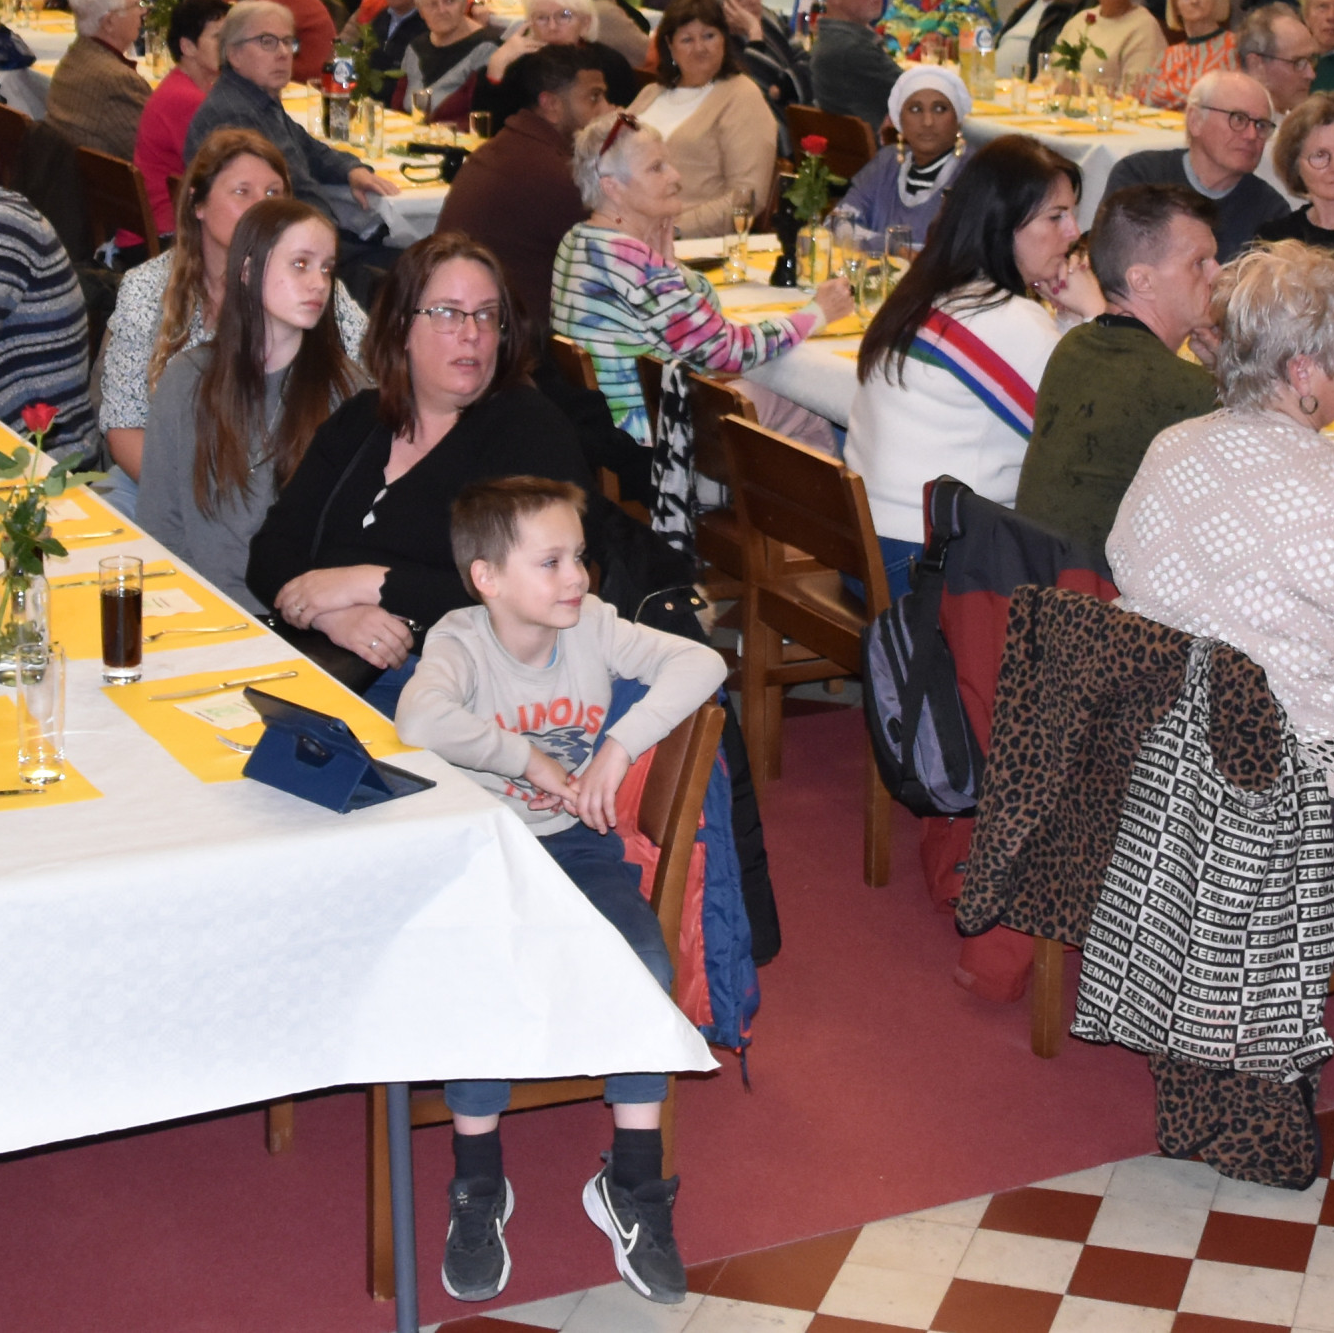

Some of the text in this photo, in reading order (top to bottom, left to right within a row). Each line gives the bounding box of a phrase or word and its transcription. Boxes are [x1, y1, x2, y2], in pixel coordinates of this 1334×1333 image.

[1134, 766, 1169, 789] EEMAN
[1130, 784, 1165, 807] EEMAN
[1125, 801, 1161, 825] EEMAN
[1120, 818, 1157, 844] EEMAN
[1219, 814, 1275, 840] ZEEMAN
[1116, 838, 1152, 862] EEMAN
[1215, 832, 1271, 857] ZEEMAN
[1112, 855, 1147, 880] EEMAN
[1210, 850, 1265, 875] ZEEMAN
[1106, 873, 1142, 899] EEMAN
[1205, 869, 1260, 892] ZEEMAN
[1101, 890, 1138, 915] EEMAN
[1154, 876, 1193, 911] ZEEMAN
[1201, 887, 1253, 908] ZEEMAN
[1095, 908, 1132, 935] EEMAN
[1149, 894, 1190, 929] ZEEMAN
[1197, 906, 1246, 926] ZEEMAN
[1090, 925, 1128, 953] EEMAN
[1143, 912, 1186, 948] ZEEMAN
[1193, 926, 1242, 945] ZEEMAN
[1086, 942, 1124, 971] EEMAN
[1139, 931, 1182, 966] ZEEMAN
[1190, 943, 1240, 964] ZEEMAN
[1082, 963, 1119, 989] EEMAN
[1134, 949, 1178, 985] ZEEMAN
[1186, 963, 1239, 982] ZEEMAN
[1129, 967, 1173, 1005] ZEEMAN
[1182, 981, 1238, 1002] ZEEMAN
[1247, 986, 1297, 1002] ZEEMAN
[1124, 986, 1168, 1024] ZEEMAN
[1179, 1001, 1236, 1021] ZEEMAN
[1244, 1004, 1298, 1021] ZEEMAN
[1118, 1004, 1165, 1040] ZEEMAN
[1174, 1019, 1233, 1039] ZEEMAN
[1241, 1023, 1298, 1039] ZEEMAN
[1172, 1037, 1230, 1057] ZEEMAN
[1239, 1040, 1299, 1054] ZEEMAN
